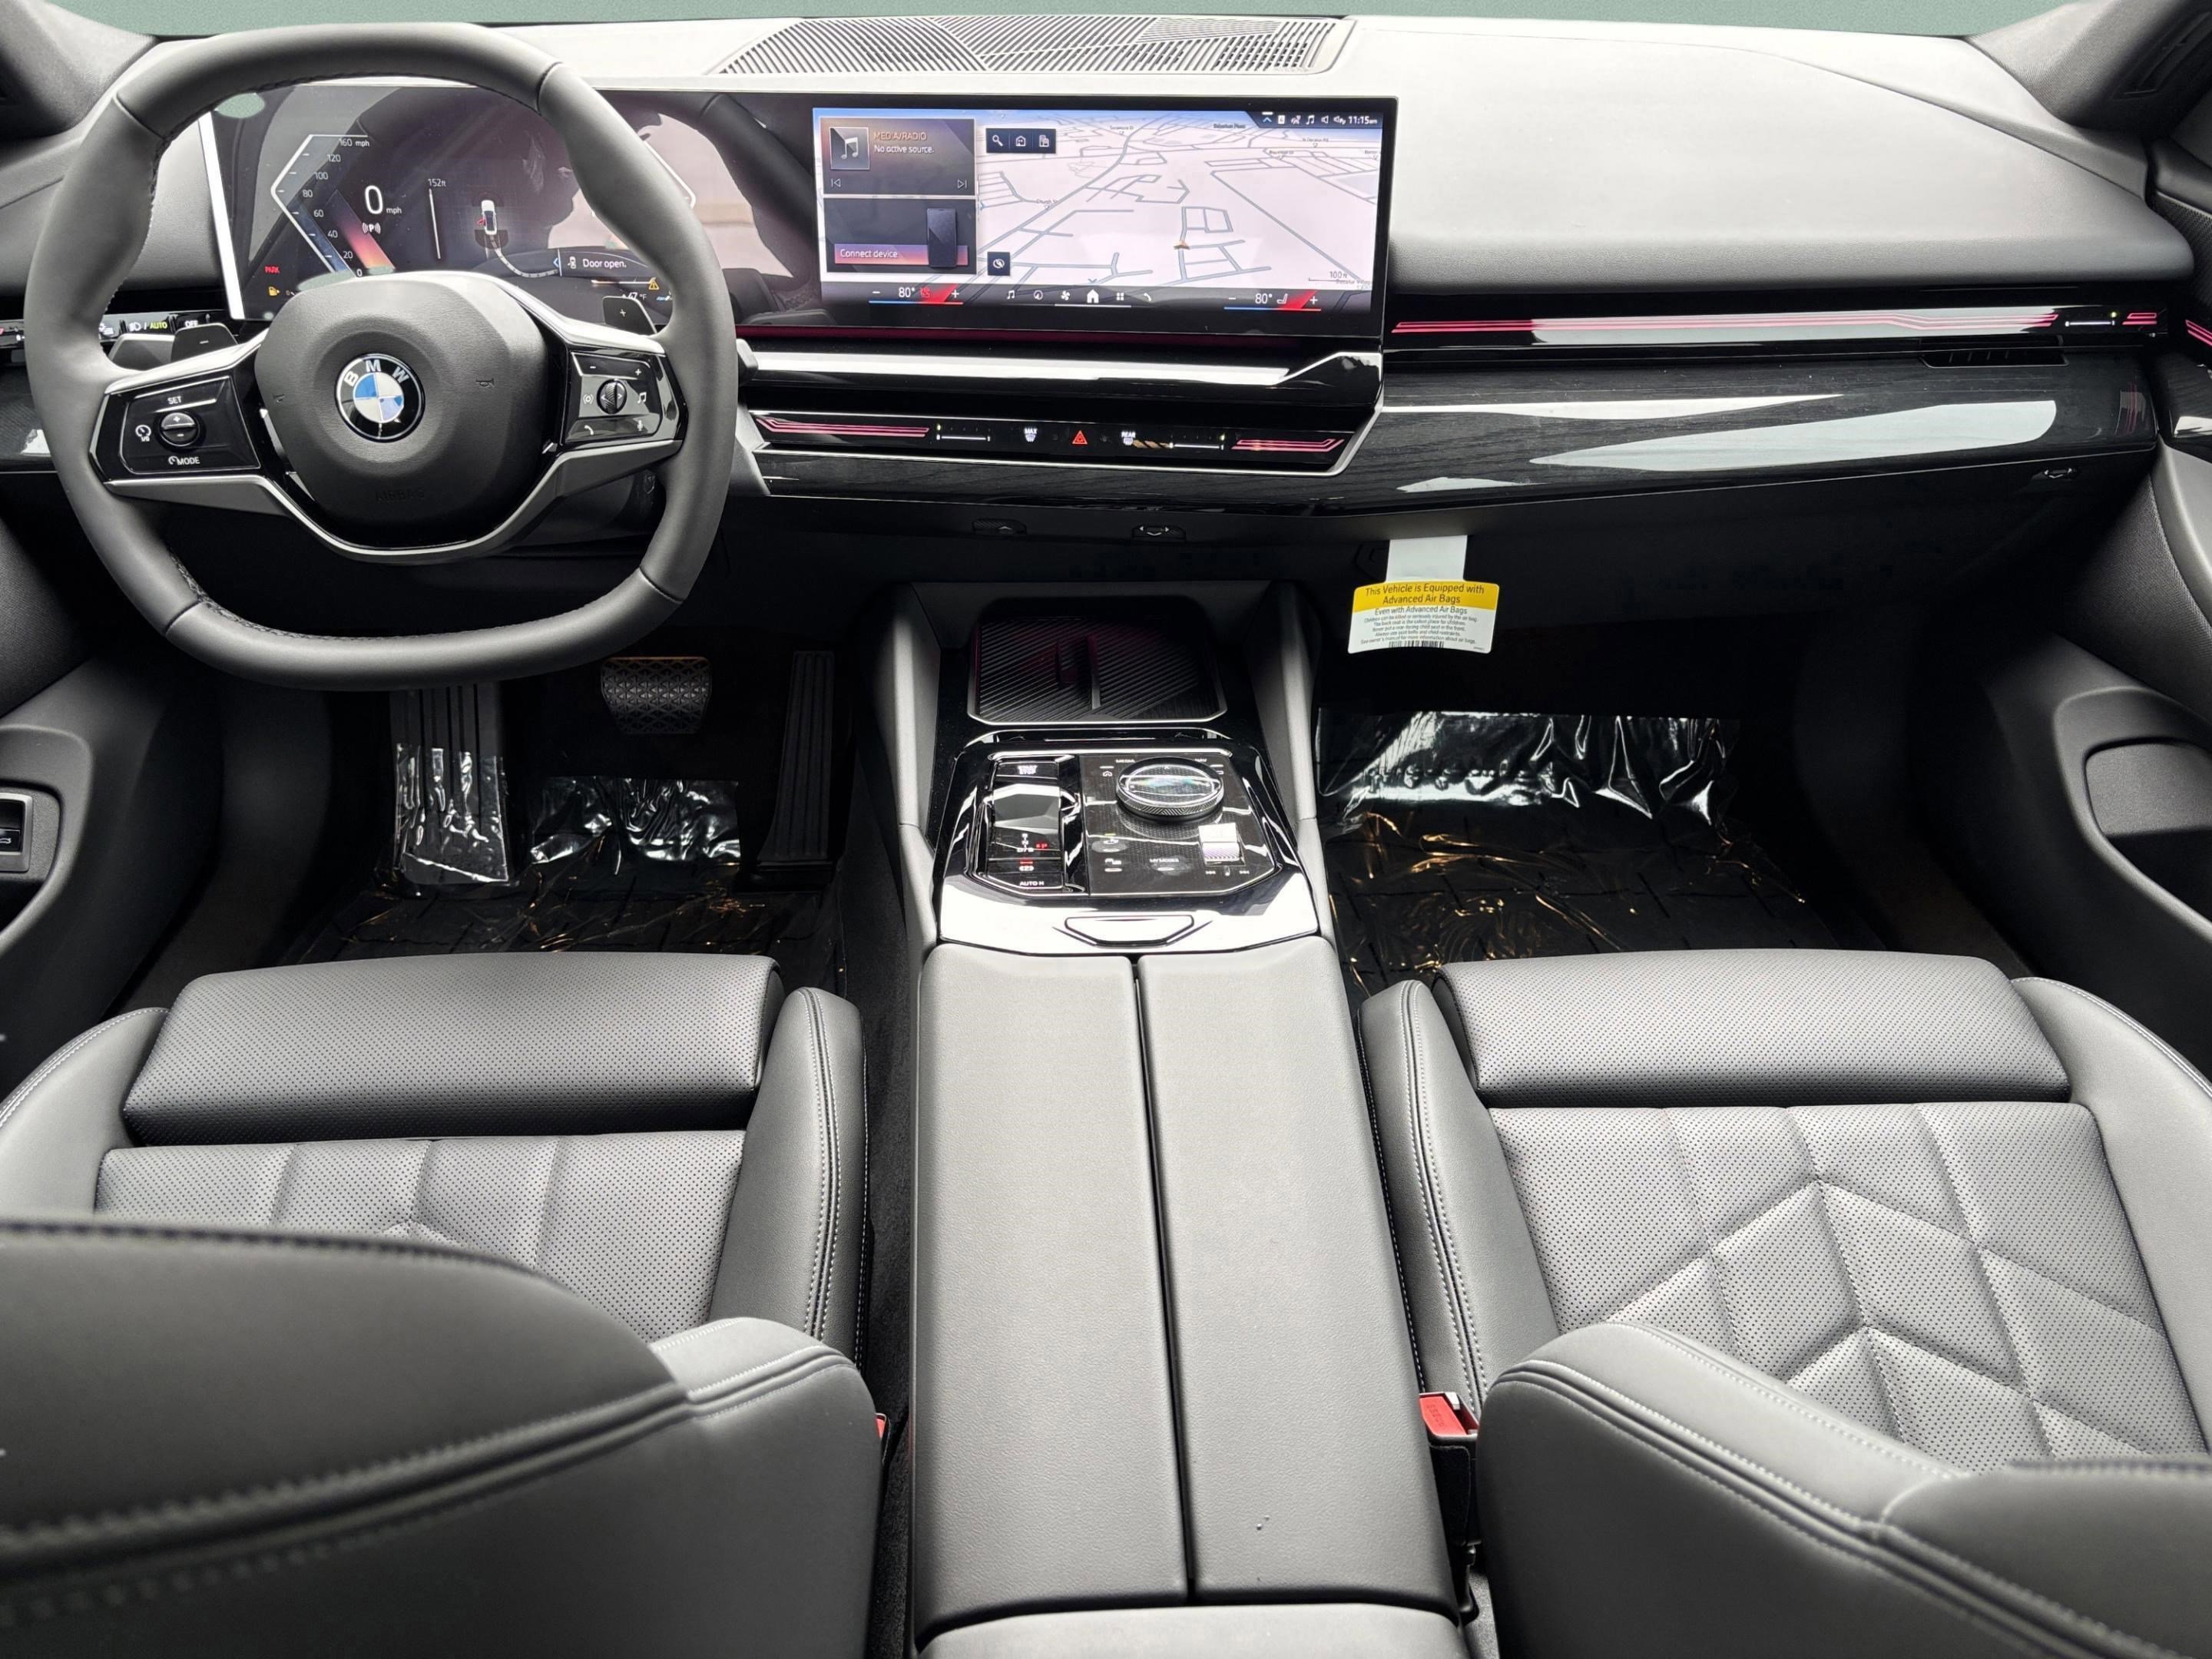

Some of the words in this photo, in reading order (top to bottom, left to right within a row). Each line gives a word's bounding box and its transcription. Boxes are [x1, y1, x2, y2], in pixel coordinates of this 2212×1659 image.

[873, 131, 926, 141] MEDIA/RADIO
[339, 138, 353, 147] 160
[874, 144, 885, 153] No
[886, 144, 906, 154] active
[909, 145, 934, 154] source.
[327, 154, 341, 162] 120
[314, 171, 329, 180] 100
[365, 185, 383, 215] 0
[313, 209, 324, 217] 60
[327, 230, 338, 238] 40
[343, 250, 353, 259] 20
[840, 249, 872, 258] Connect
[873, 249, 898, 258] device
[583, 258, 602, 268] Door
[604, 261, 627, 270] open.
[356, 269, 363, 277] 0
[150, 321, 167, 329] AUTO
[343, 359, 409, 387] BMW
[167, 396, 181, 404] SET
[177, 456, 200, 465] MODE
[1366, 588, 1381, 596] This
[1382, 584, 1412, 594] Vehicle
[1423, 583, 1464, 594] Equipped
[1466, 584, 1485, 594] with
[1382, 594, 1423, 604] Advanced
[1425, 594, 1436, 603] Air
[1439, 594, 1461, 604] Bags
[1450, 606, 1468, 614] Bags
